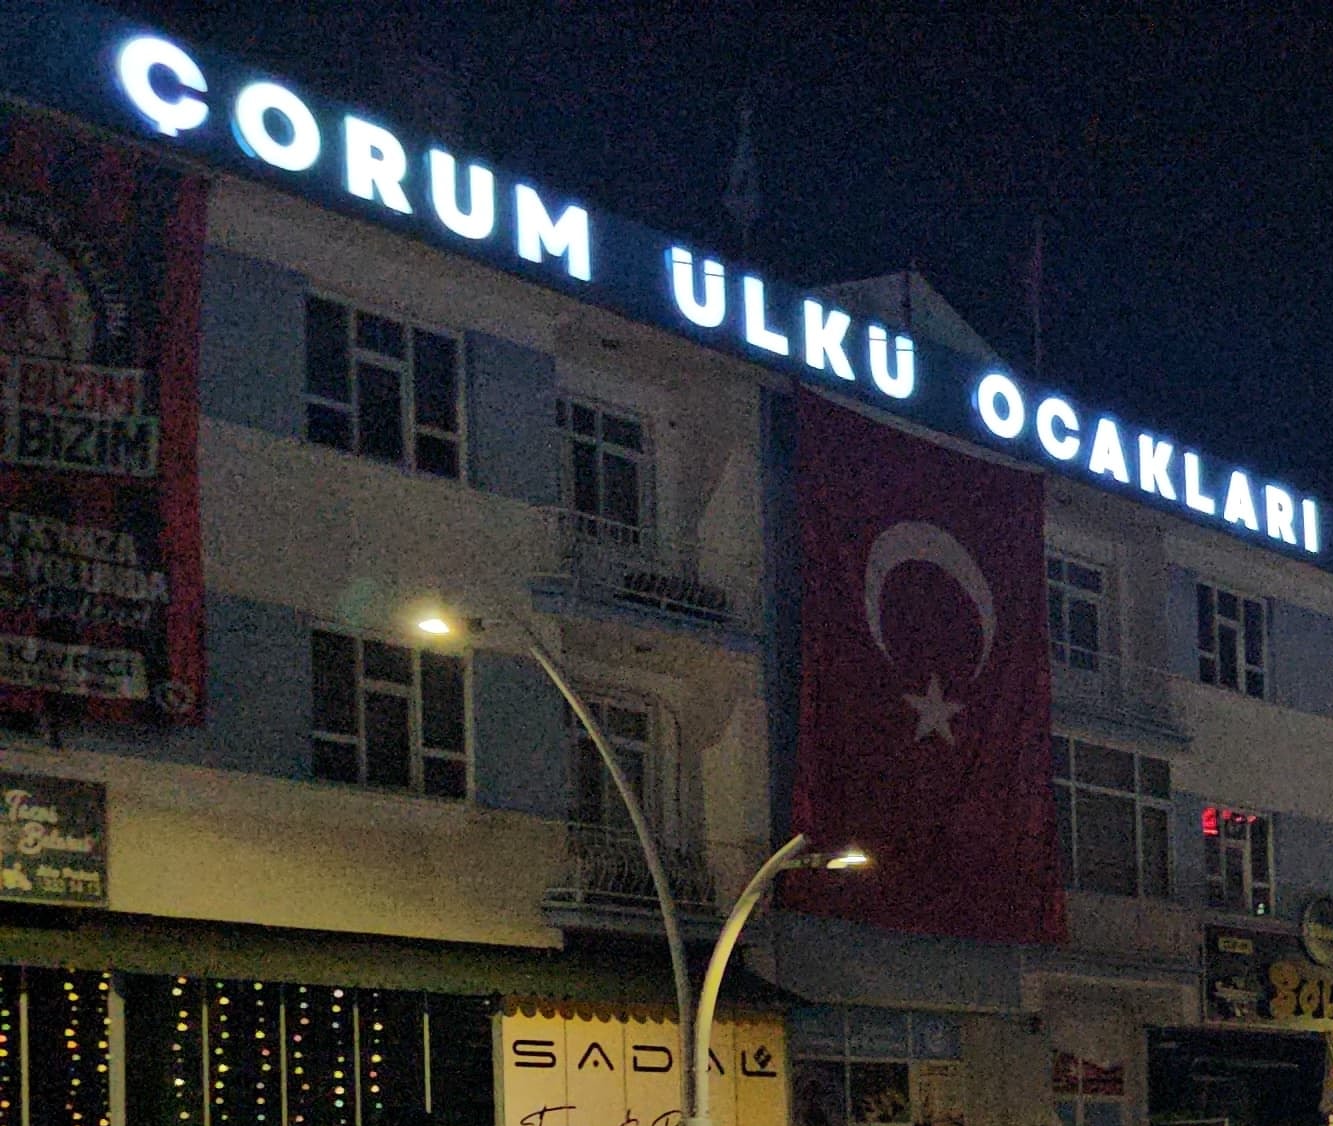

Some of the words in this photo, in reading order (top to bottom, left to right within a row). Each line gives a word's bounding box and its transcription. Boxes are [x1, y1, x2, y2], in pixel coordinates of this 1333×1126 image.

[118, 36, 592, 282] ÇORUM
[670, 246, 916, 399] ÜLKÜ
[976, 372, 1322, 554] OCAKLARI
